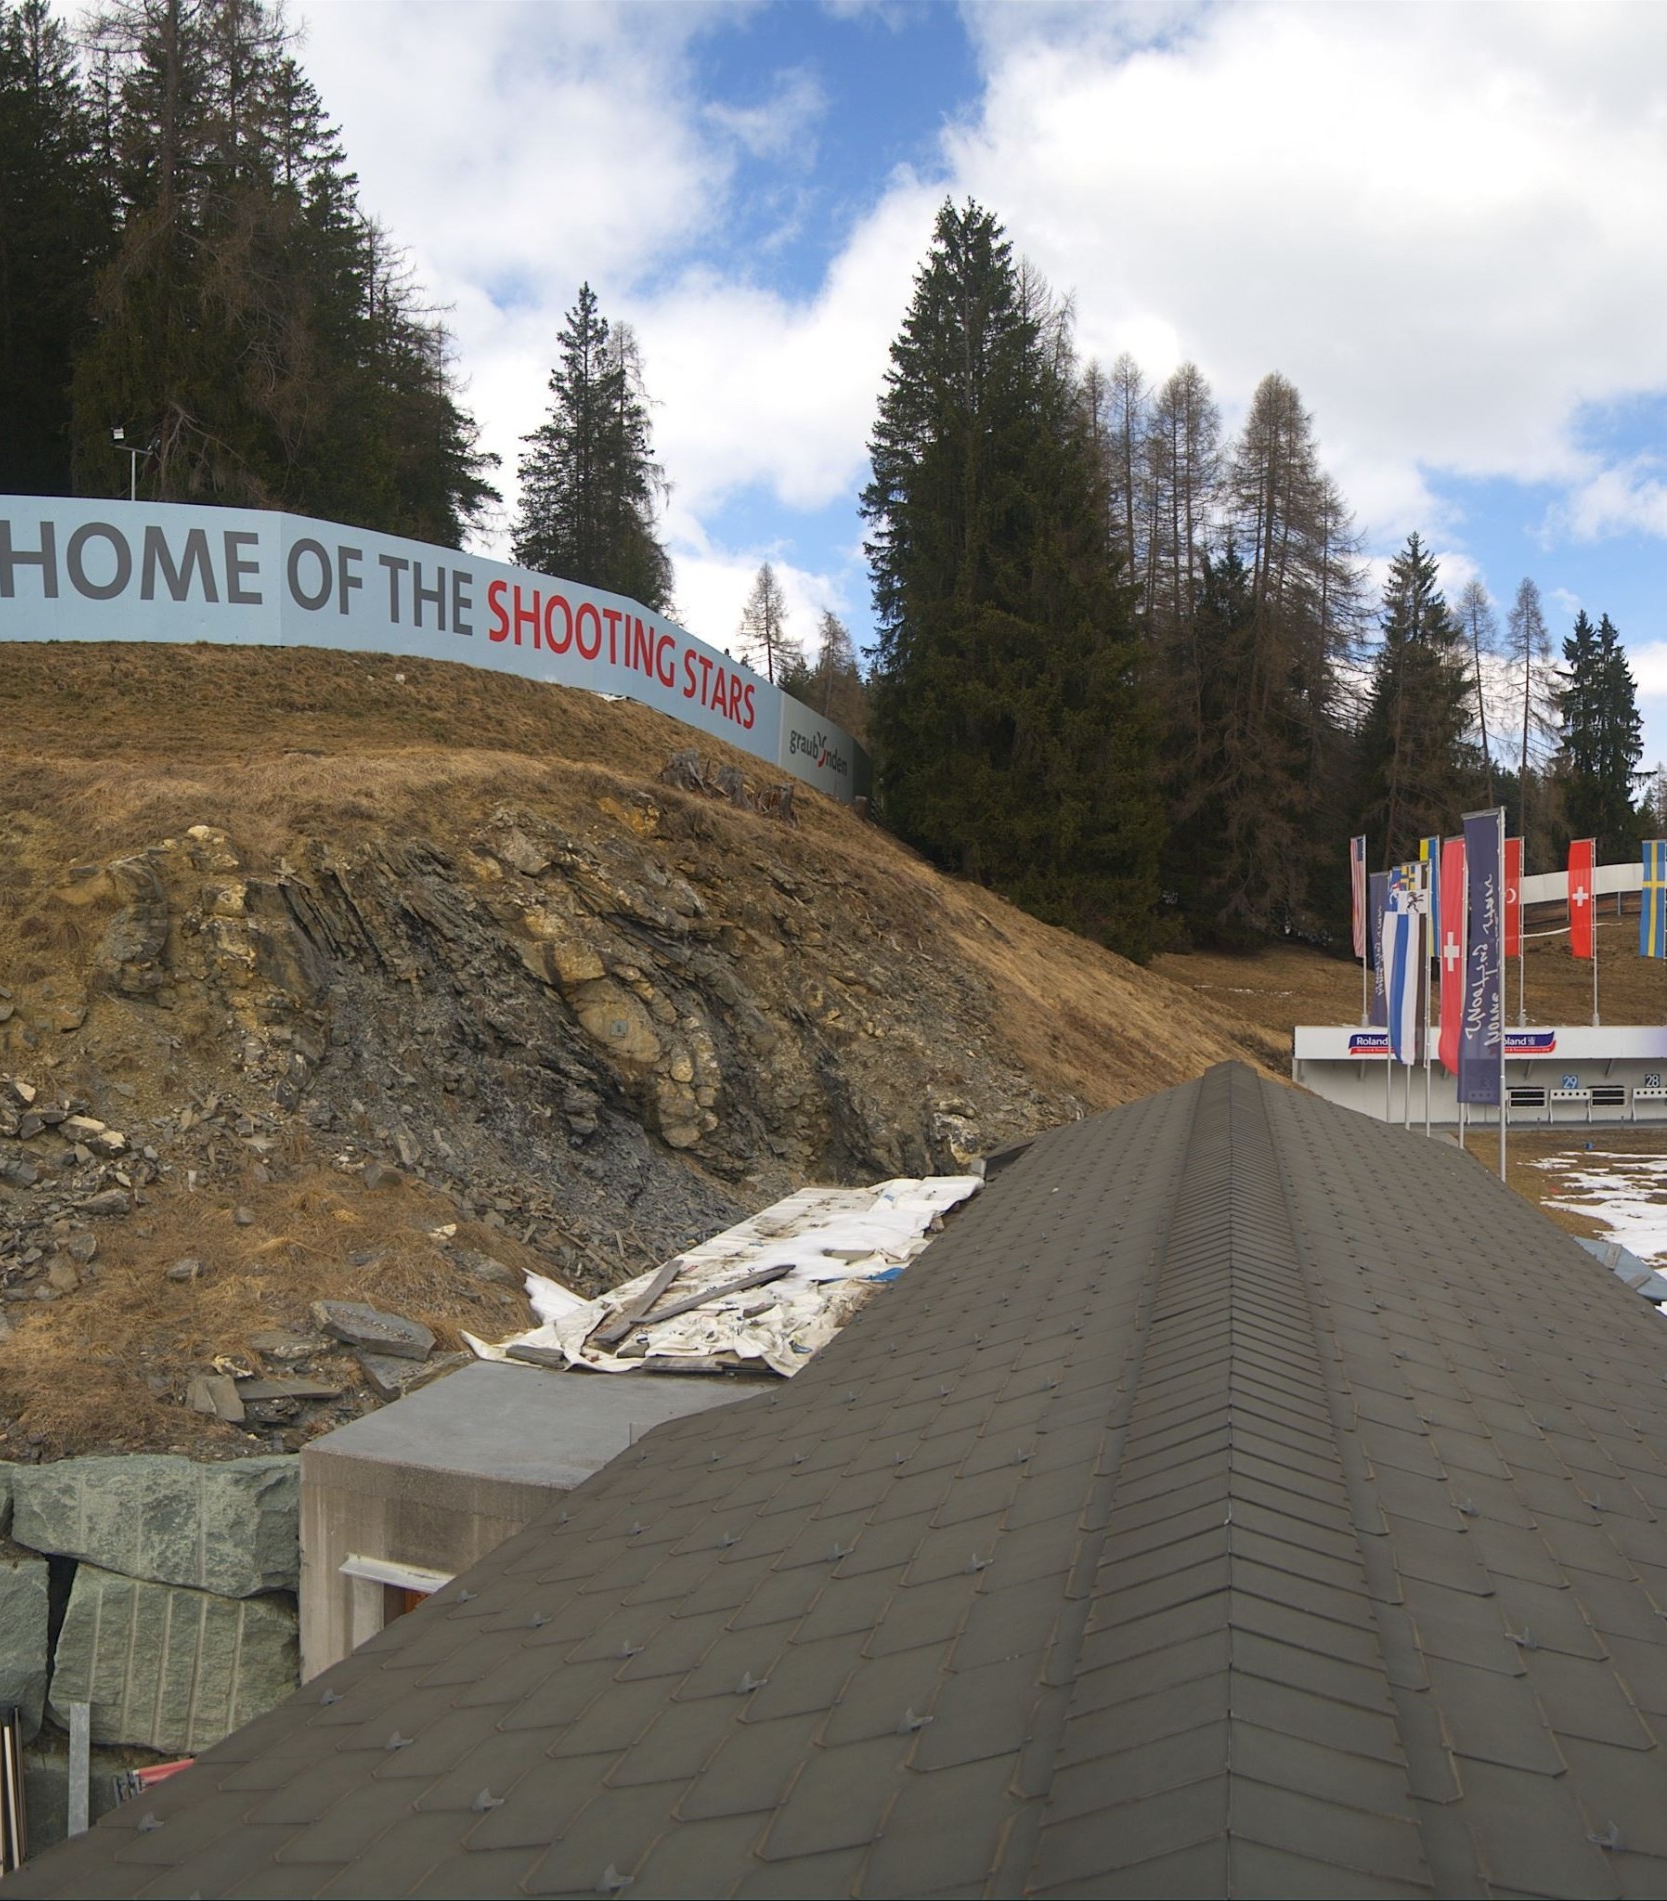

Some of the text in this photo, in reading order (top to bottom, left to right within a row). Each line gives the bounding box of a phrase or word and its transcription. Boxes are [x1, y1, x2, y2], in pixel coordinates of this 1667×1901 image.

[287, 538, 363, 616] OF
[378, 553, 473, 636] THE
[487, 580, 675, 688] SHOOTING
[683, 648, 755, 730] STARS
[1356, 1037, 1389, 1046] Roland
[1563, 1075, 1579, 1089] 29
[1645, 1074, 1659, 1088] 28
